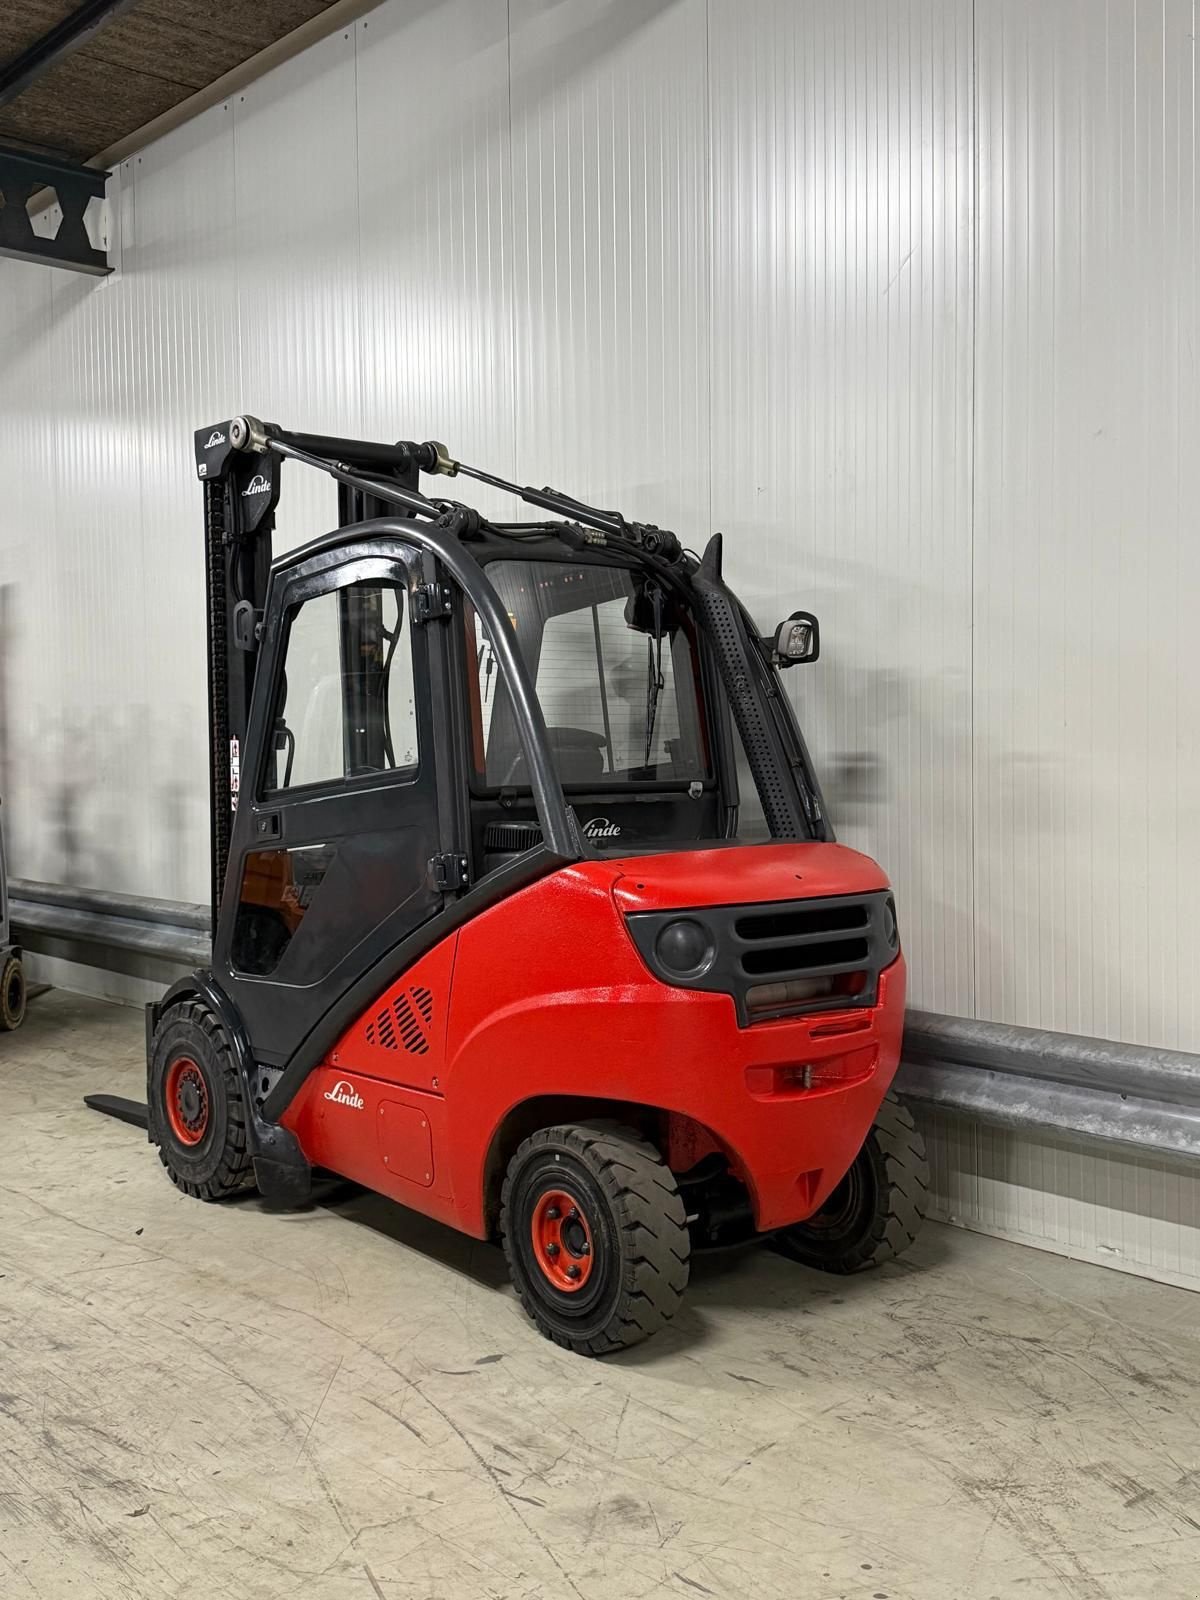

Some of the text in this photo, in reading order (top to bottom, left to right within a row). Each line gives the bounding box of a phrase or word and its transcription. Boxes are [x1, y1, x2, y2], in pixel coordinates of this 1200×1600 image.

[204, 431, 226, 449] Linde
[241, 475, 271, 497] Linde
[324, 1081, 364, 1110] Linde
